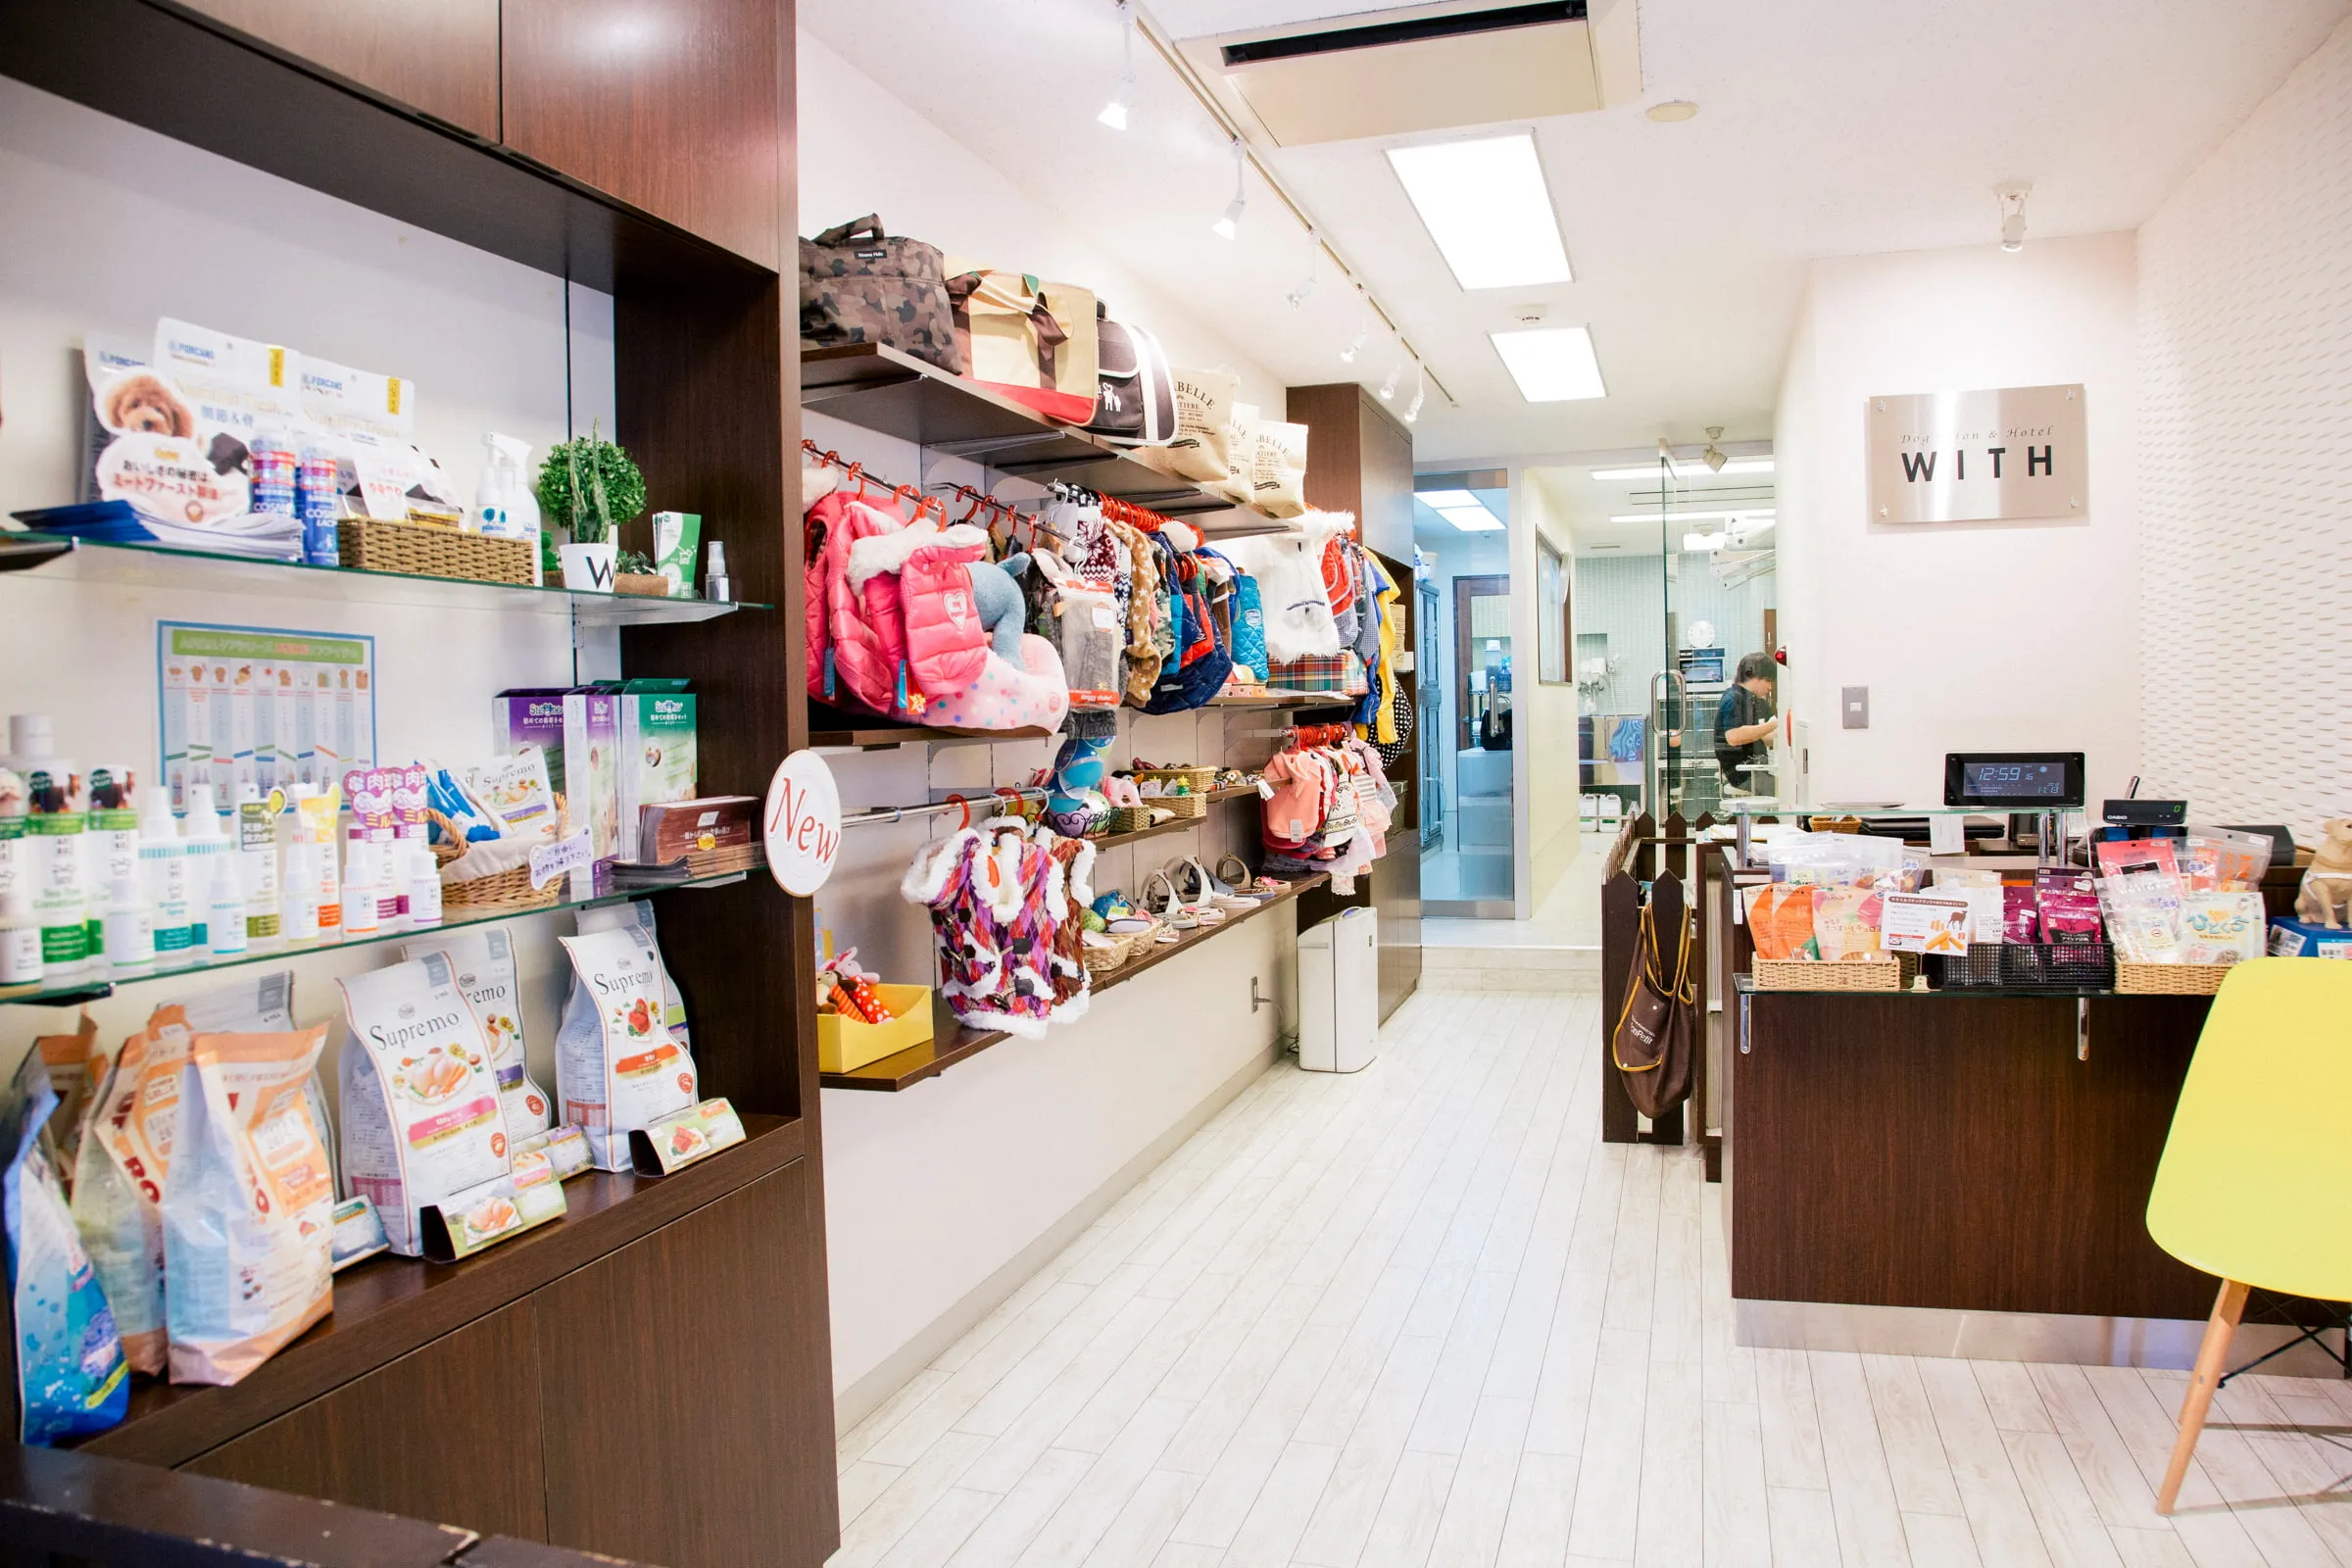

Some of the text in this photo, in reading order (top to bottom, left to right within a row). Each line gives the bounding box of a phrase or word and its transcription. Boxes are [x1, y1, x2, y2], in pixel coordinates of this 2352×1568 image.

[1176, 380, 1216, 411] BELLE
[1900, 434, 1930, 446] Dog
[1988, 429, 1997, 440] &
[2007, 424, 2055, 438] Hotel
[1901, 445, 2052, 483] WITH
[482, 762, 537, 786] Supremo
[1980, 767, 2021, 781] 12:59
[769, 777, 840, 864] New
[466, 985, 506, 1004] remo
[593, 970, 654, 996] Supremo
[369, 1012, 460, 1052] Supremo
